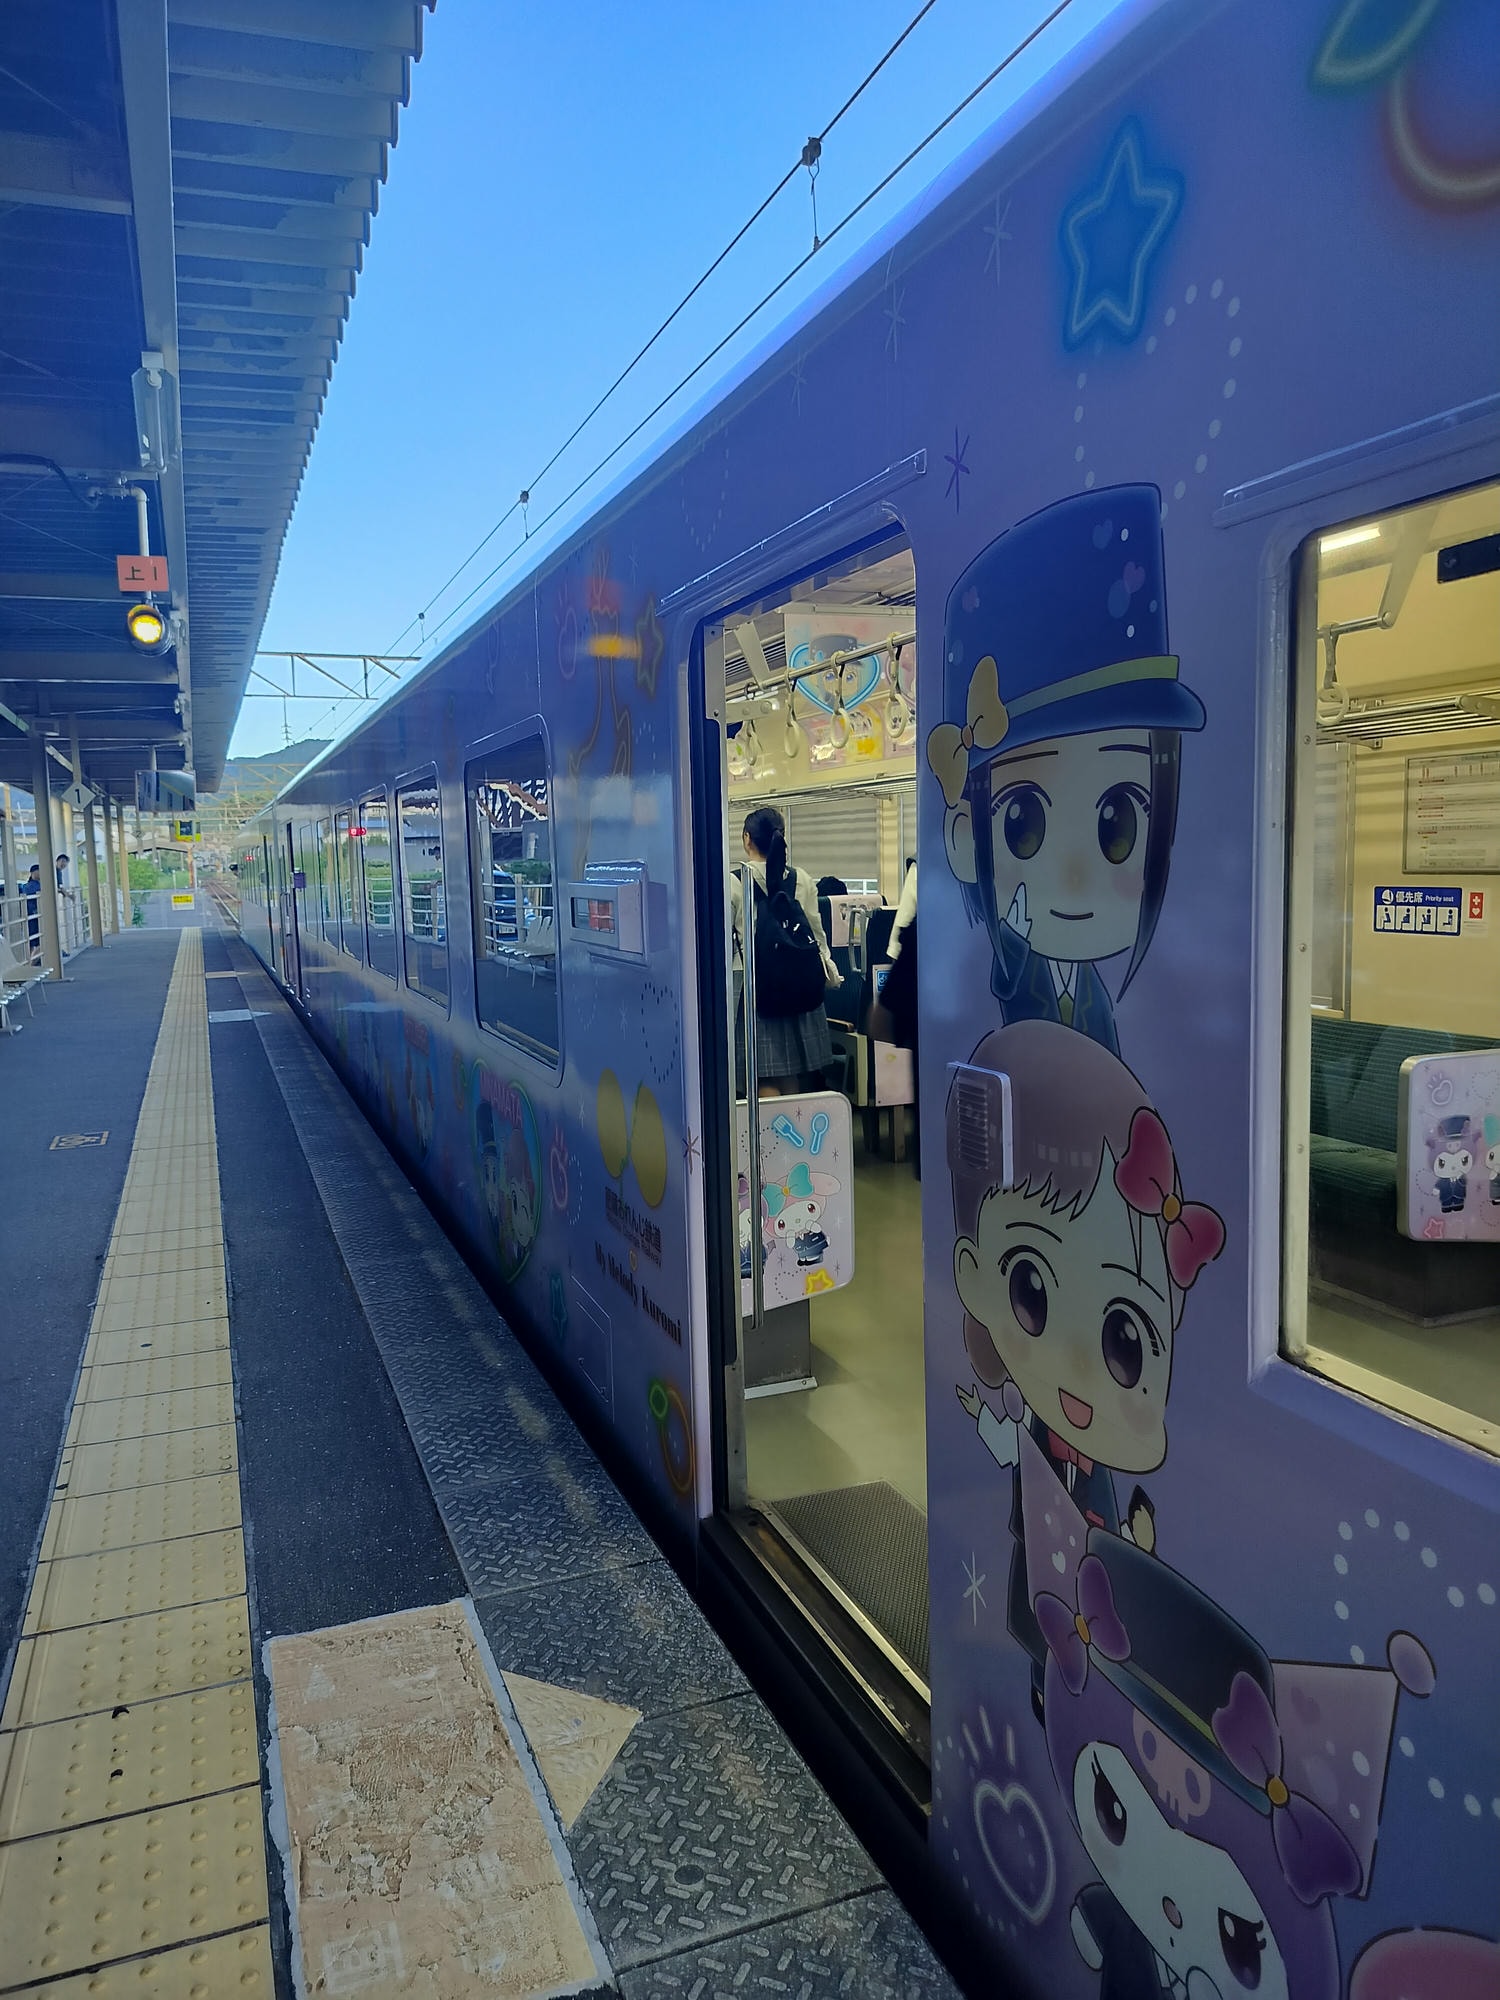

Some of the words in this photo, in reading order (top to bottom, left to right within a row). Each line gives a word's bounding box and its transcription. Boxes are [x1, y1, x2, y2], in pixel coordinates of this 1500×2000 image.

[75, 788, 81, 804] 1
[1395, 891, 1423, 903] 優先席
[1425, 895, 1442, 903] Priority
[642, 1285, 681, 1347] Kuromi
